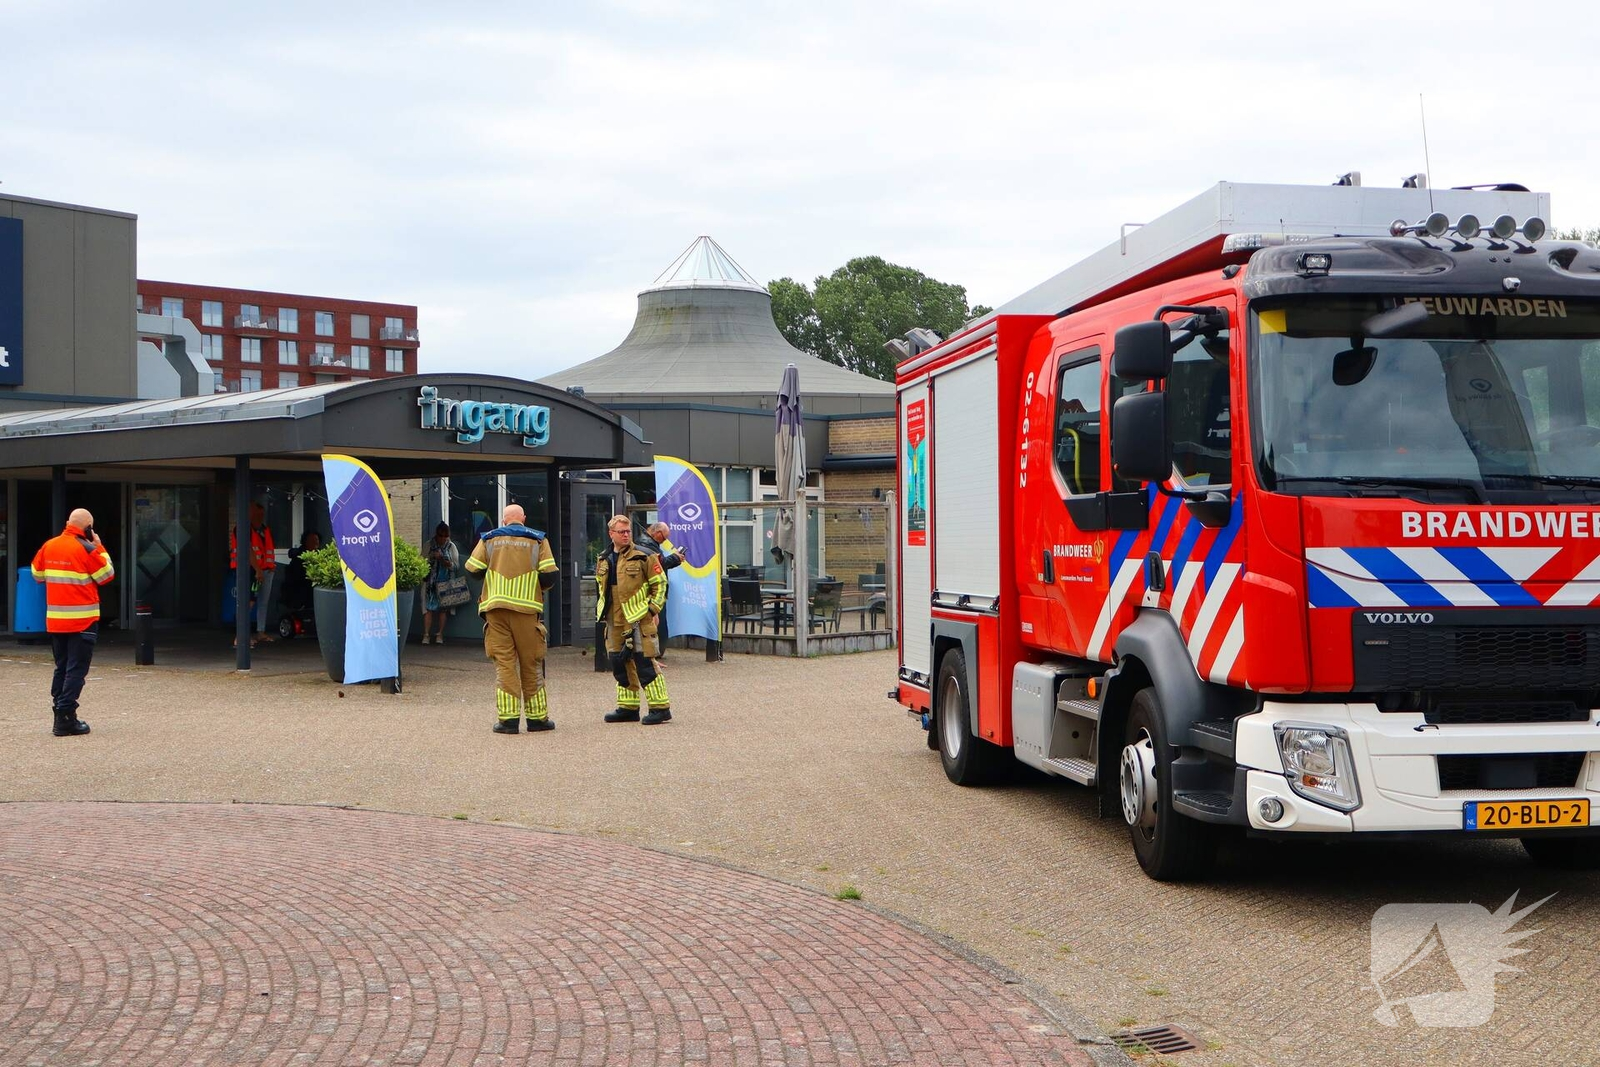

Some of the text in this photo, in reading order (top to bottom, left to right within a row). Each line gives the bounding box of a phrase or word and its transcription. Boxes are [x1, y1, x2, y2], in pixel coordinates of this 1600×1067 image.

[417, 386, 550, 447] ingang
[1020, 372, 1034, 488] 02-6132
[1053, 545, 1093, 557] BRANDWEER
[1363, 612, 1434, 624] VOLVO
[1484, 804, 1582, 826] 20-BLD-2
